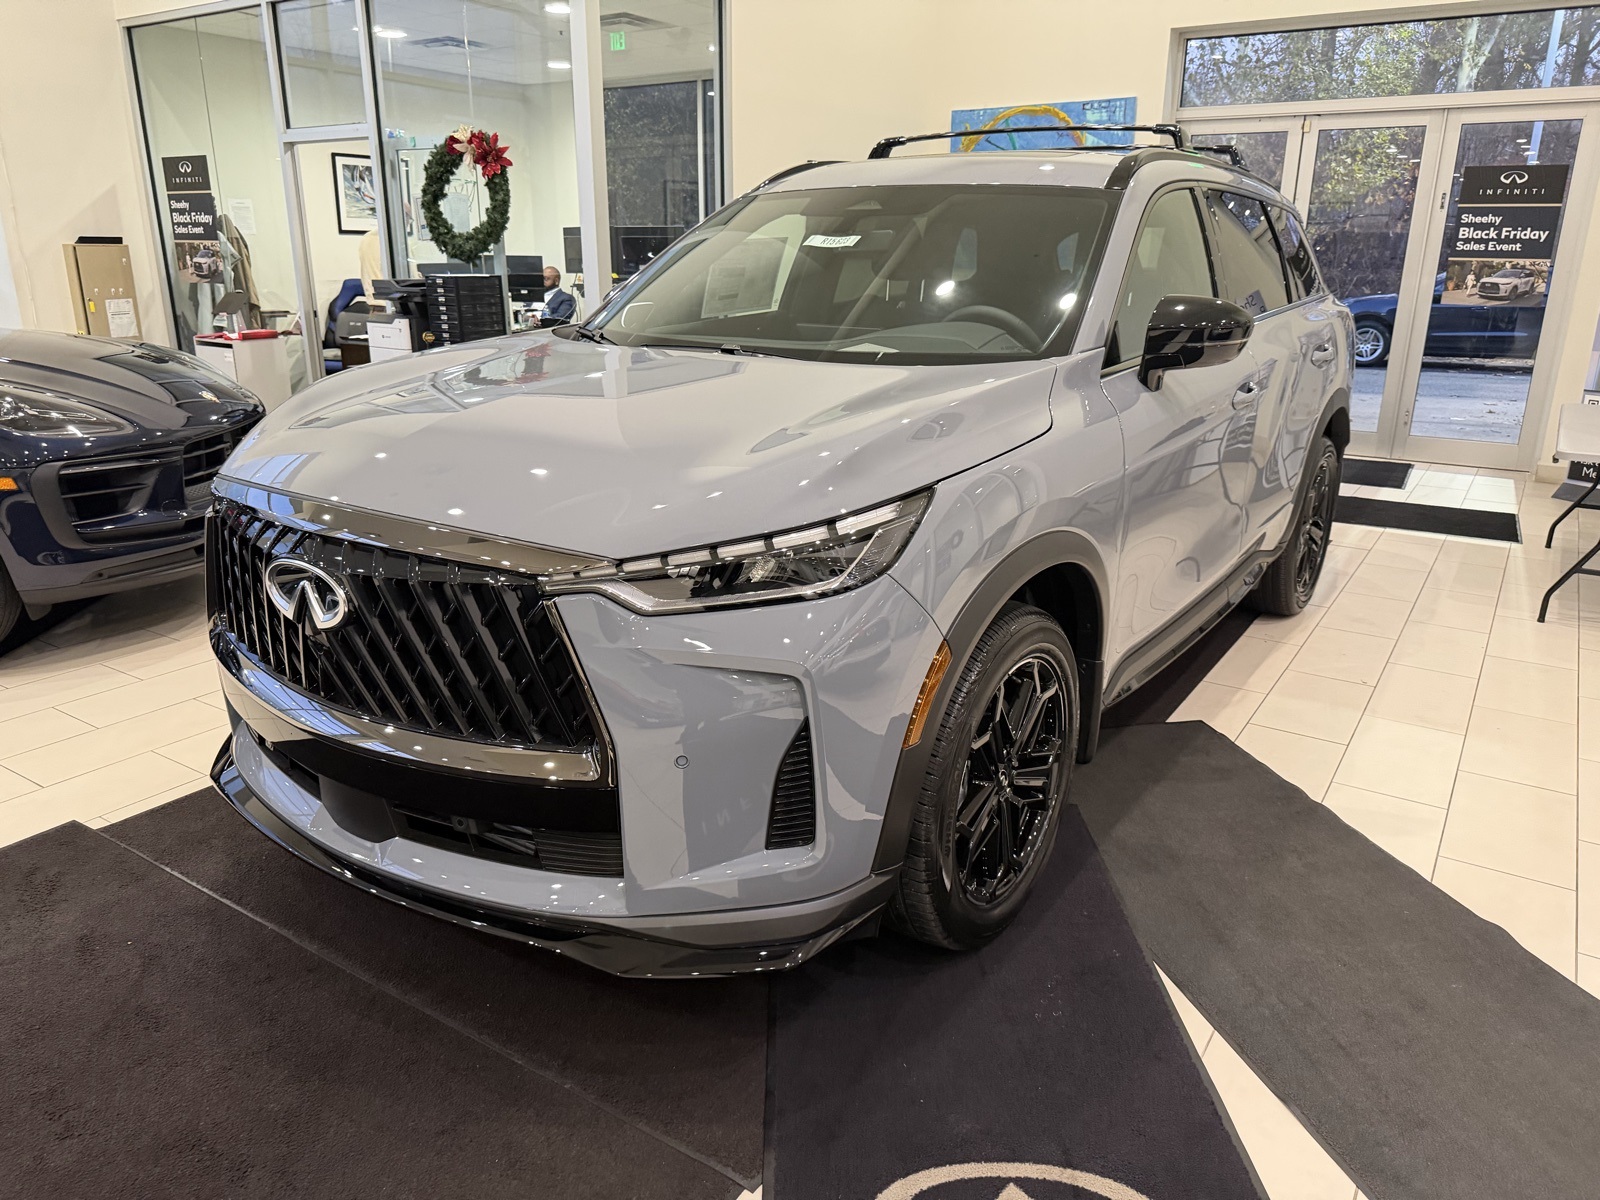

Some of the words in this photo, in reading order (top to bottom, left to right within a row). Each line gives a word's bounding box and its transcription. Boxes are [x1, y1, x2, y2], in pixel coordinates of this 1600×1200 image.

[170, 200, 190, 210] Sheehy
[172, 212, 191, 223] Black
[191, 212, 213, 226] Friday
[1460, 213, 1503, 226] Sheehy
[174, 225, 188, 234] Sales
[188, 225, 205, 234] Event
[1458, 227, 1499, 239] Black
[1501, 227, 1549, 242] Friday
[1455, 241, 1486, 251] Sales
[1487, 241, 1522, 251] Event
